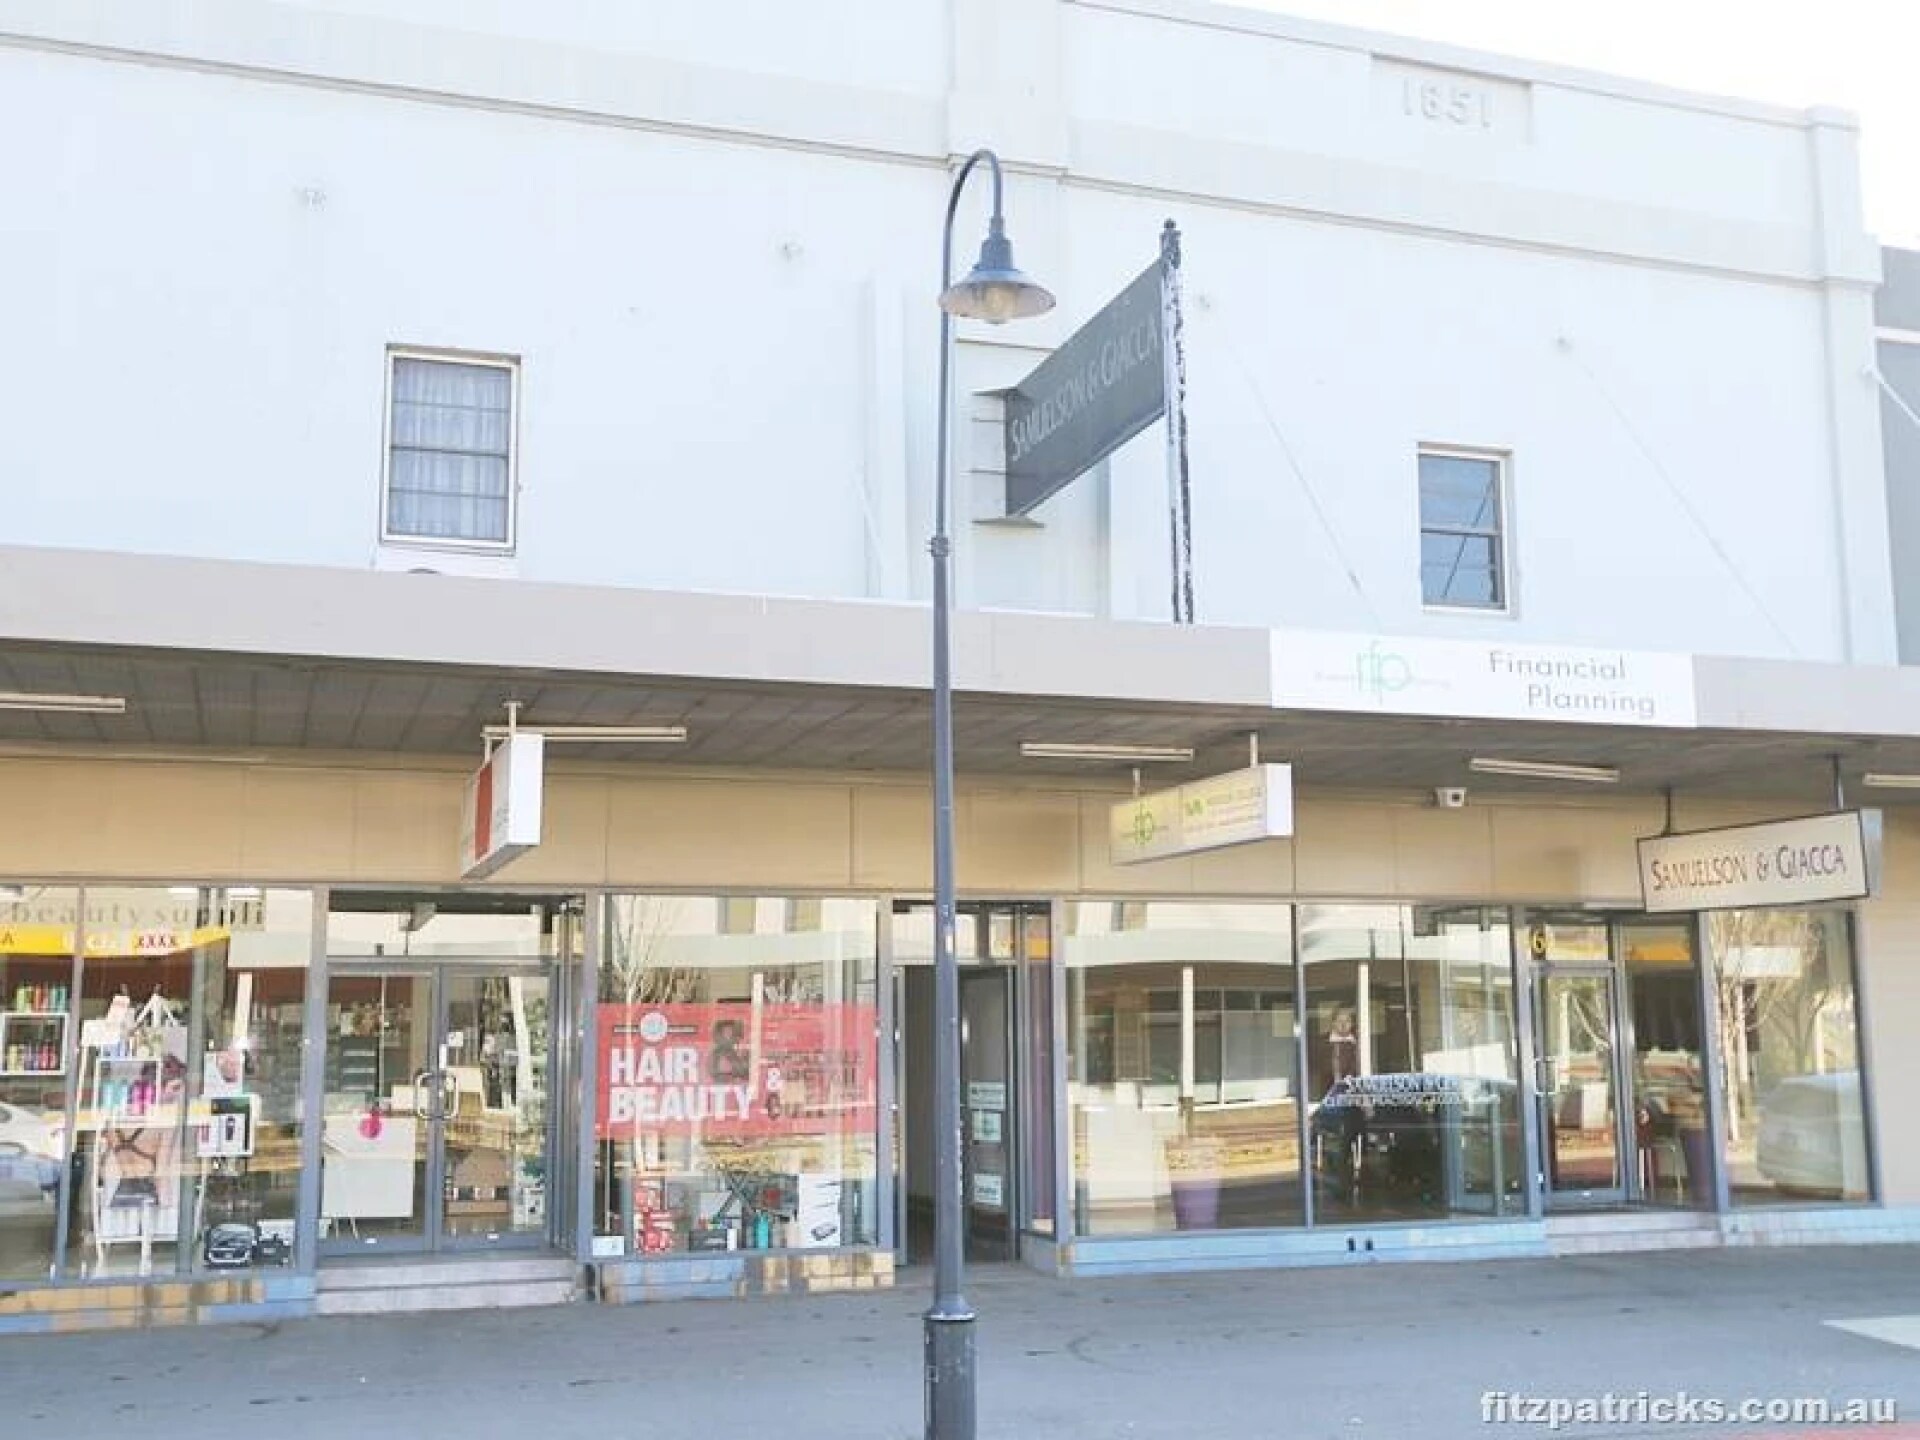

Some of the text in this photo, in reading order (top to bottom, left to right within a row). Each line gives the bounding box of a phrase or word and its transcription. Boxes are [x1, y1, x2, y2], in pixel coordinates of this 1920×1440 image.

[1489, 649, 1626, 680] Financial
[1527, 683, 1655, 718] Planning
[1651, 845, 1848, 892] SAMUELSON & GIACCA
[11, 901, 140, 924] beauty
[610, 1047, 699, 1084] HAIR
[609, 1085, 753, 1122] BEAUTY
